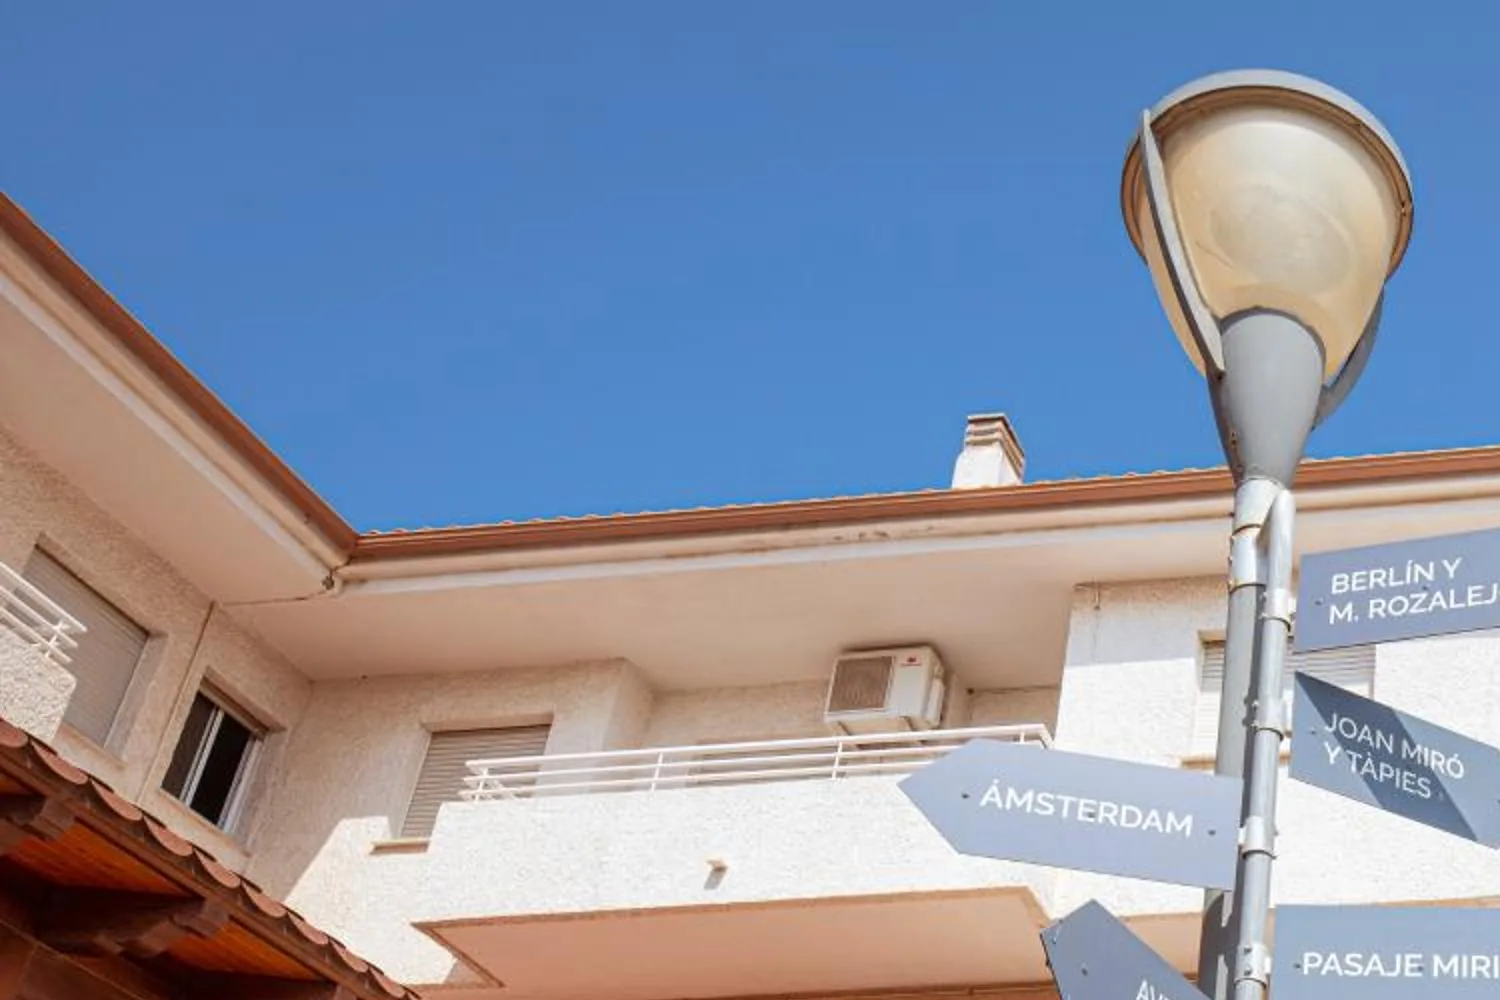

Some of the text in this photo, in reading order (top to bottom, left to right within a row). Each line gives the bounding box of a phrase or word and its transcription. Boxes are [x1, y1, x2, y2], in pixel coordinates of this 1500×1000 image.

[1331, 557, 1463, 595] BERLÍN Y
[1328, 603, 1359, 625] M.
[1323, 741, 1432, 800] Y TÀPIES
[1324, 713, 1466, 780] JOAN MIRÓ
[979, 778, 1194, 838] ÁMSTERDAM
[1302, 951, 1424, 978] PASAJE
